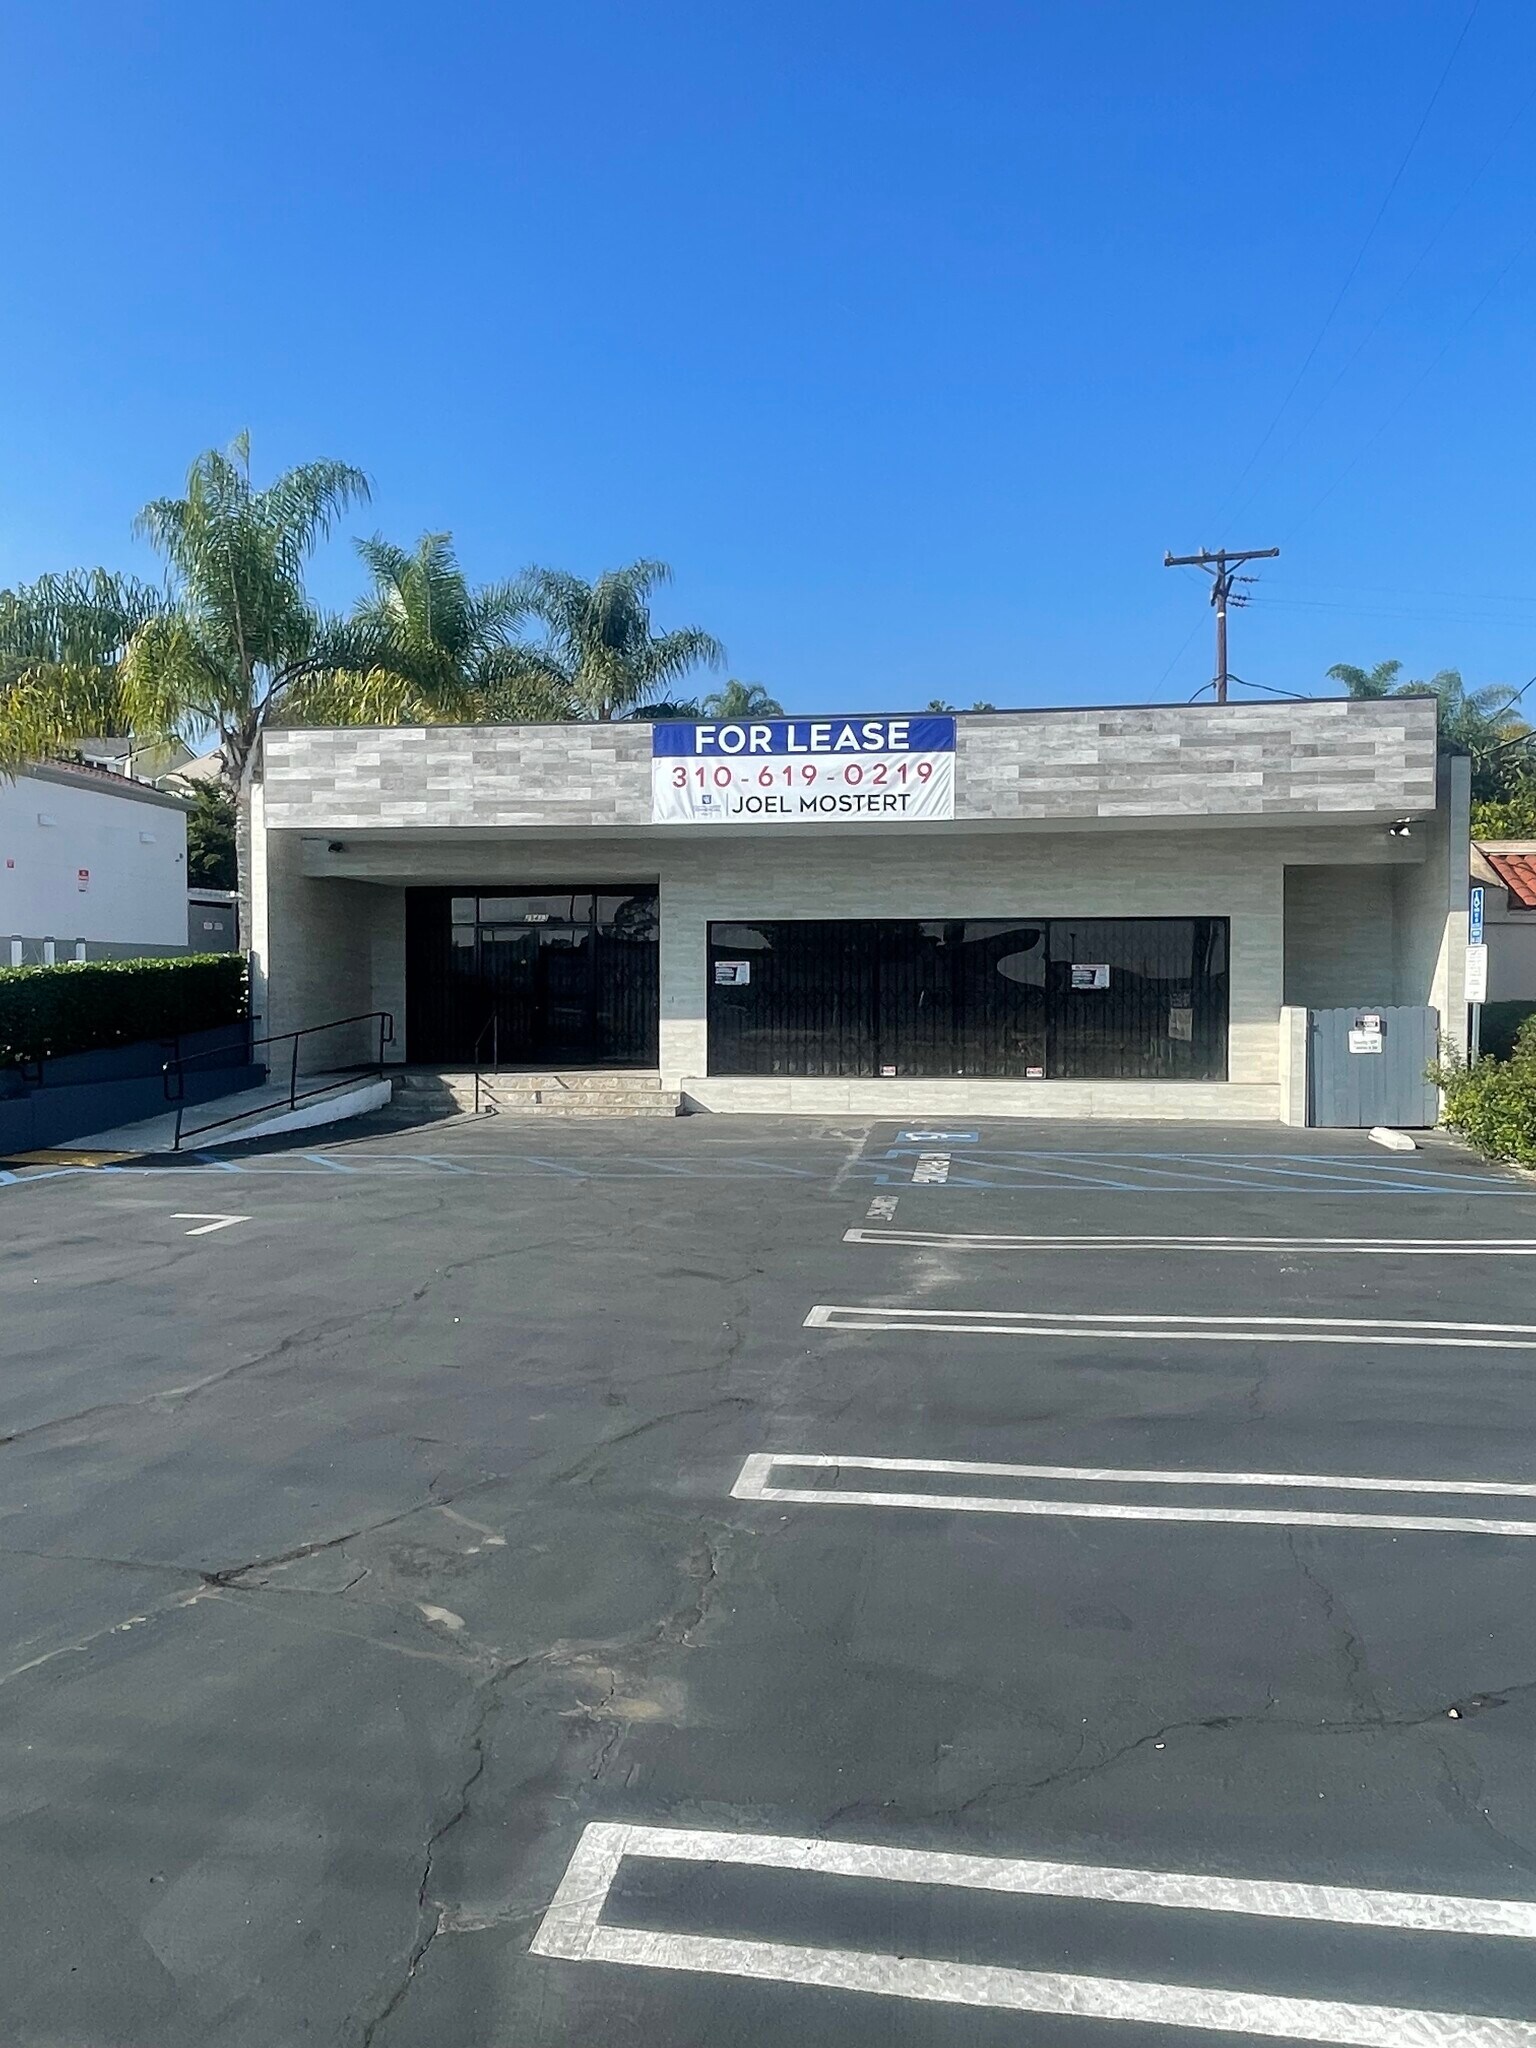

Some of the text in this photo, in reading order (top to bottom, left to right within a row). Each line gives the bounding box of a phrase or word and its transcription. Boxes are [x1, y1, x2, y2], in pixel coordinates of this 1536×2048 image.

[695, 722, 910, 753] FOR LEASE
[672, 762, 933, 788] 310-619-0219
[732, 796, 792, 813] JOEL
[799, 794, 911, 813] MOSTERT
